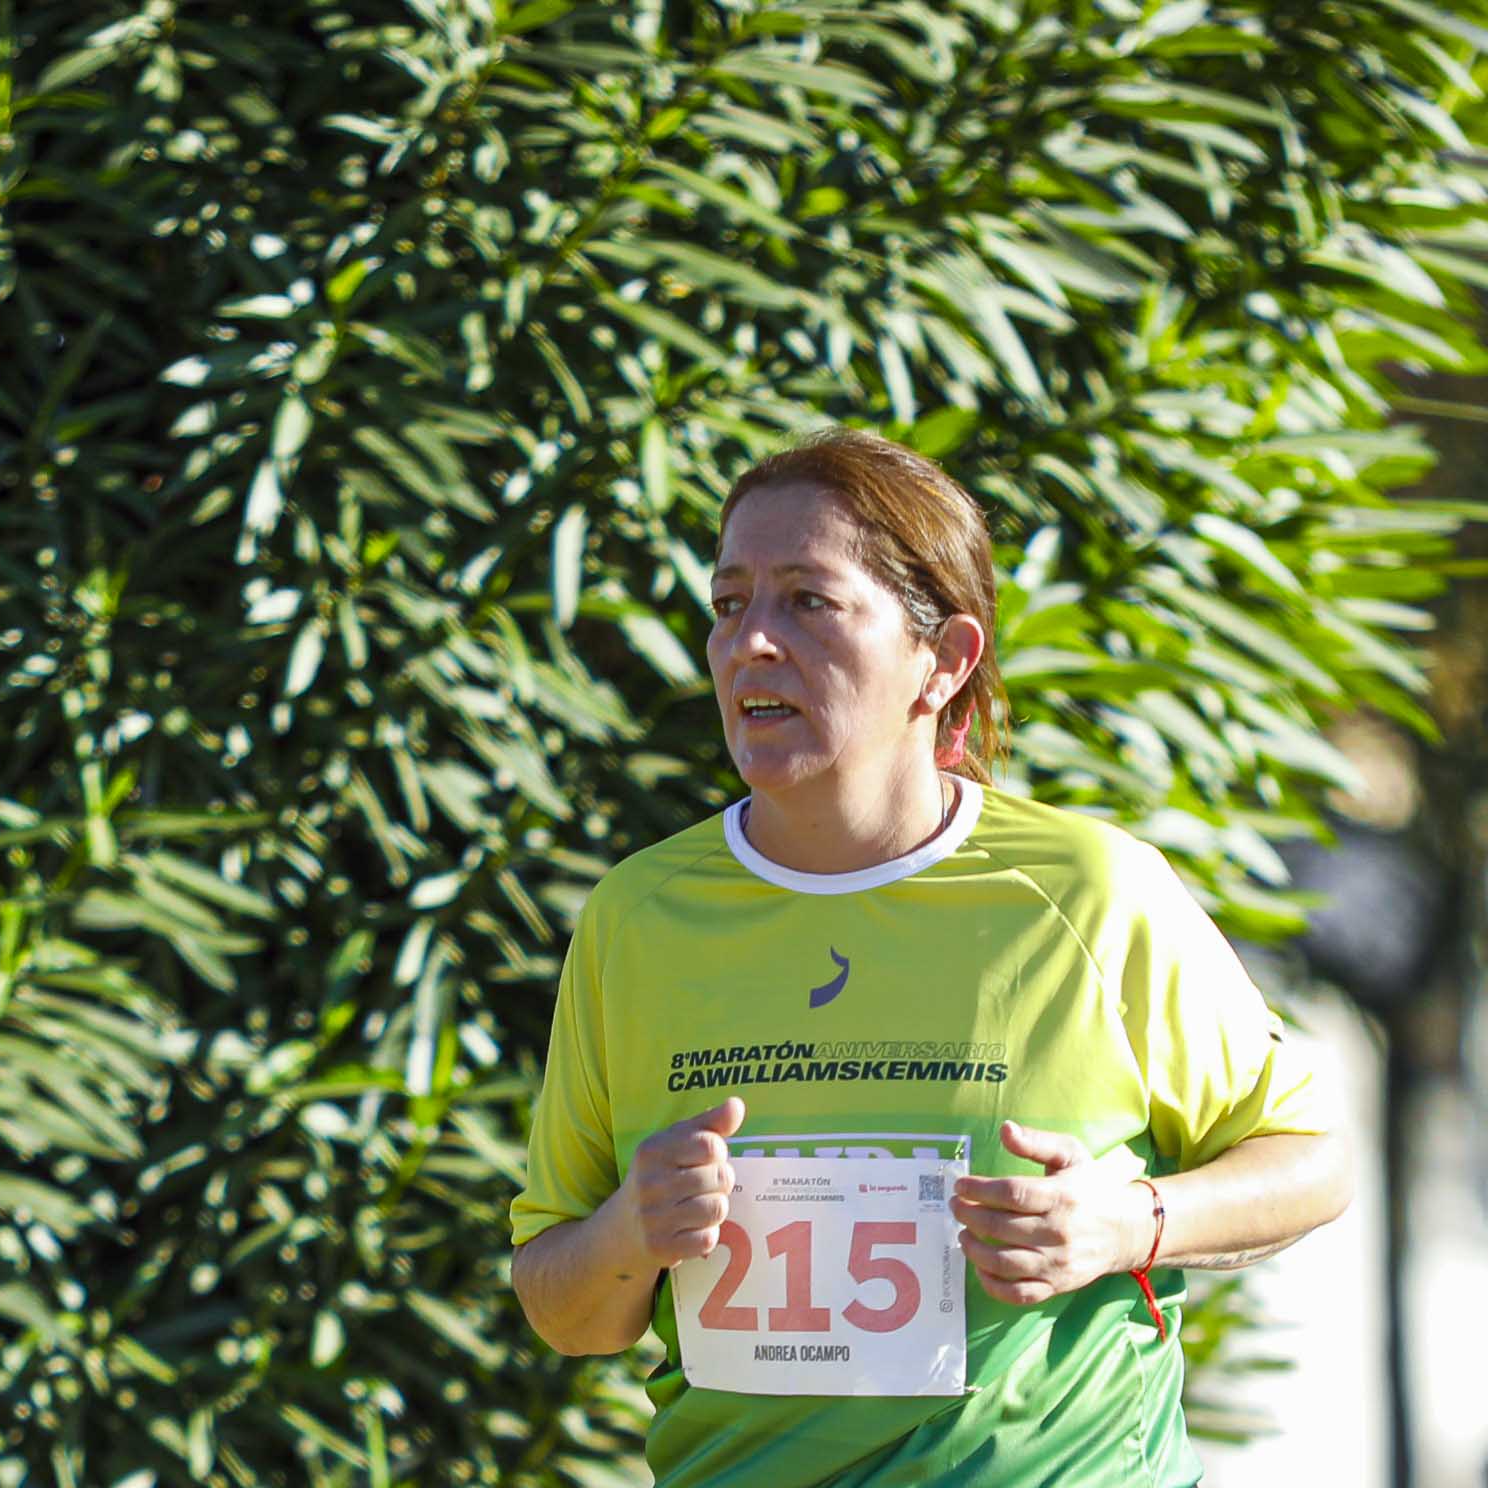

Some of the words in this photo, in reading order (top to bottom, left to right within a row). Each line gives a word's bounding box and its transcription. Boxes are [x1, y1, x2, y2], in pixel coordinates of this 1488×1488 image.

[666, 1060, 1009, 1093] CAWILLIAMSKEMMIS
[698, 1219, 921, 1333] 215
[754, 1345, 797, 1361] ANDREA
[800, 1345, 850, 1362] OCAMPO
